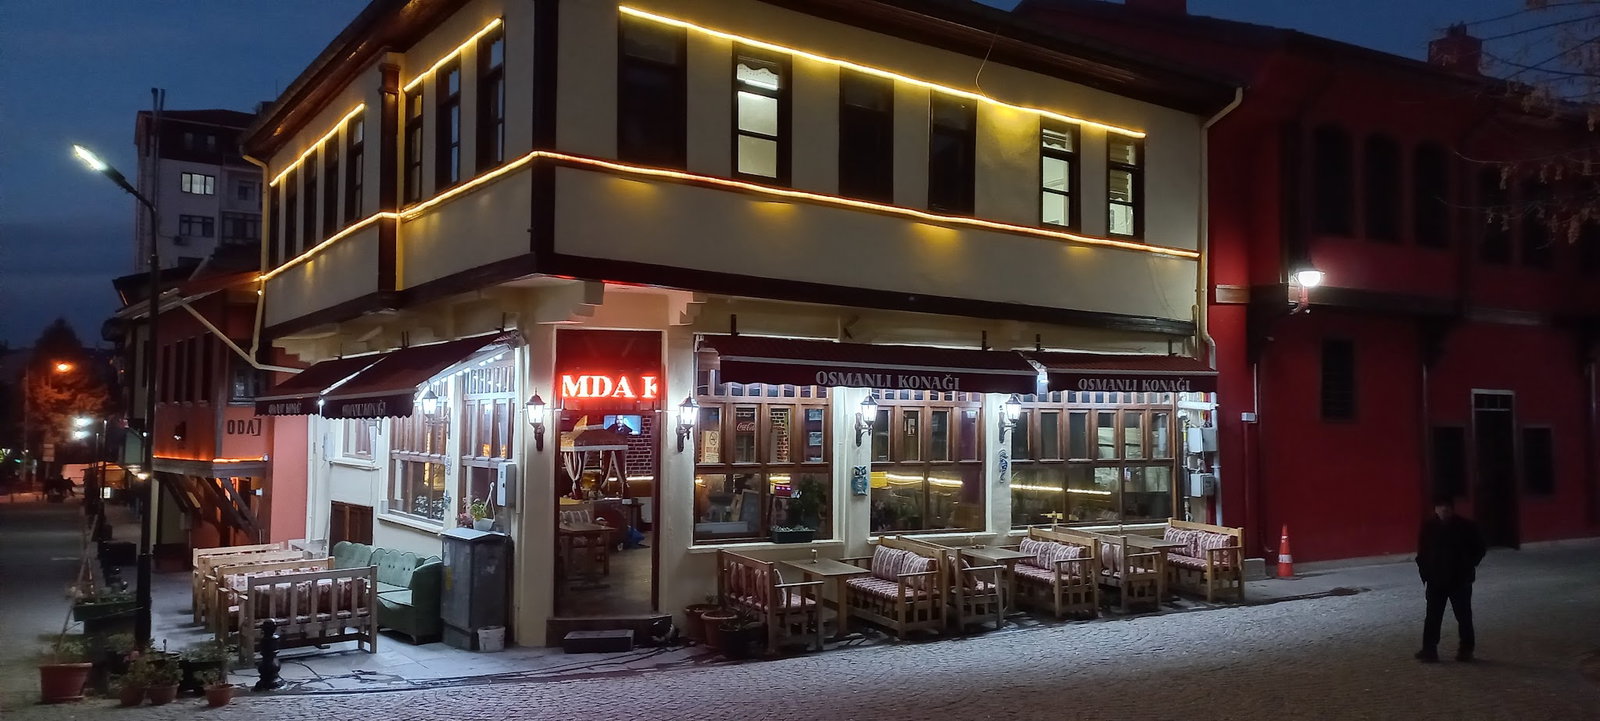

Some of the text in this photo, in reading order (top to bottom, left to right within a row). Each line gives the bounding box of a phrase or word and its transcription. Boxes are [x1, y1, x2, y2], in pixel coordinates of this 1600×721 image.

[562, 375, 635, 398] MDA
[815, 371, 960, 390] OSMANLI KONAĞI
[1078, 377, 1191, 392] OSMANLI KONAĞI
